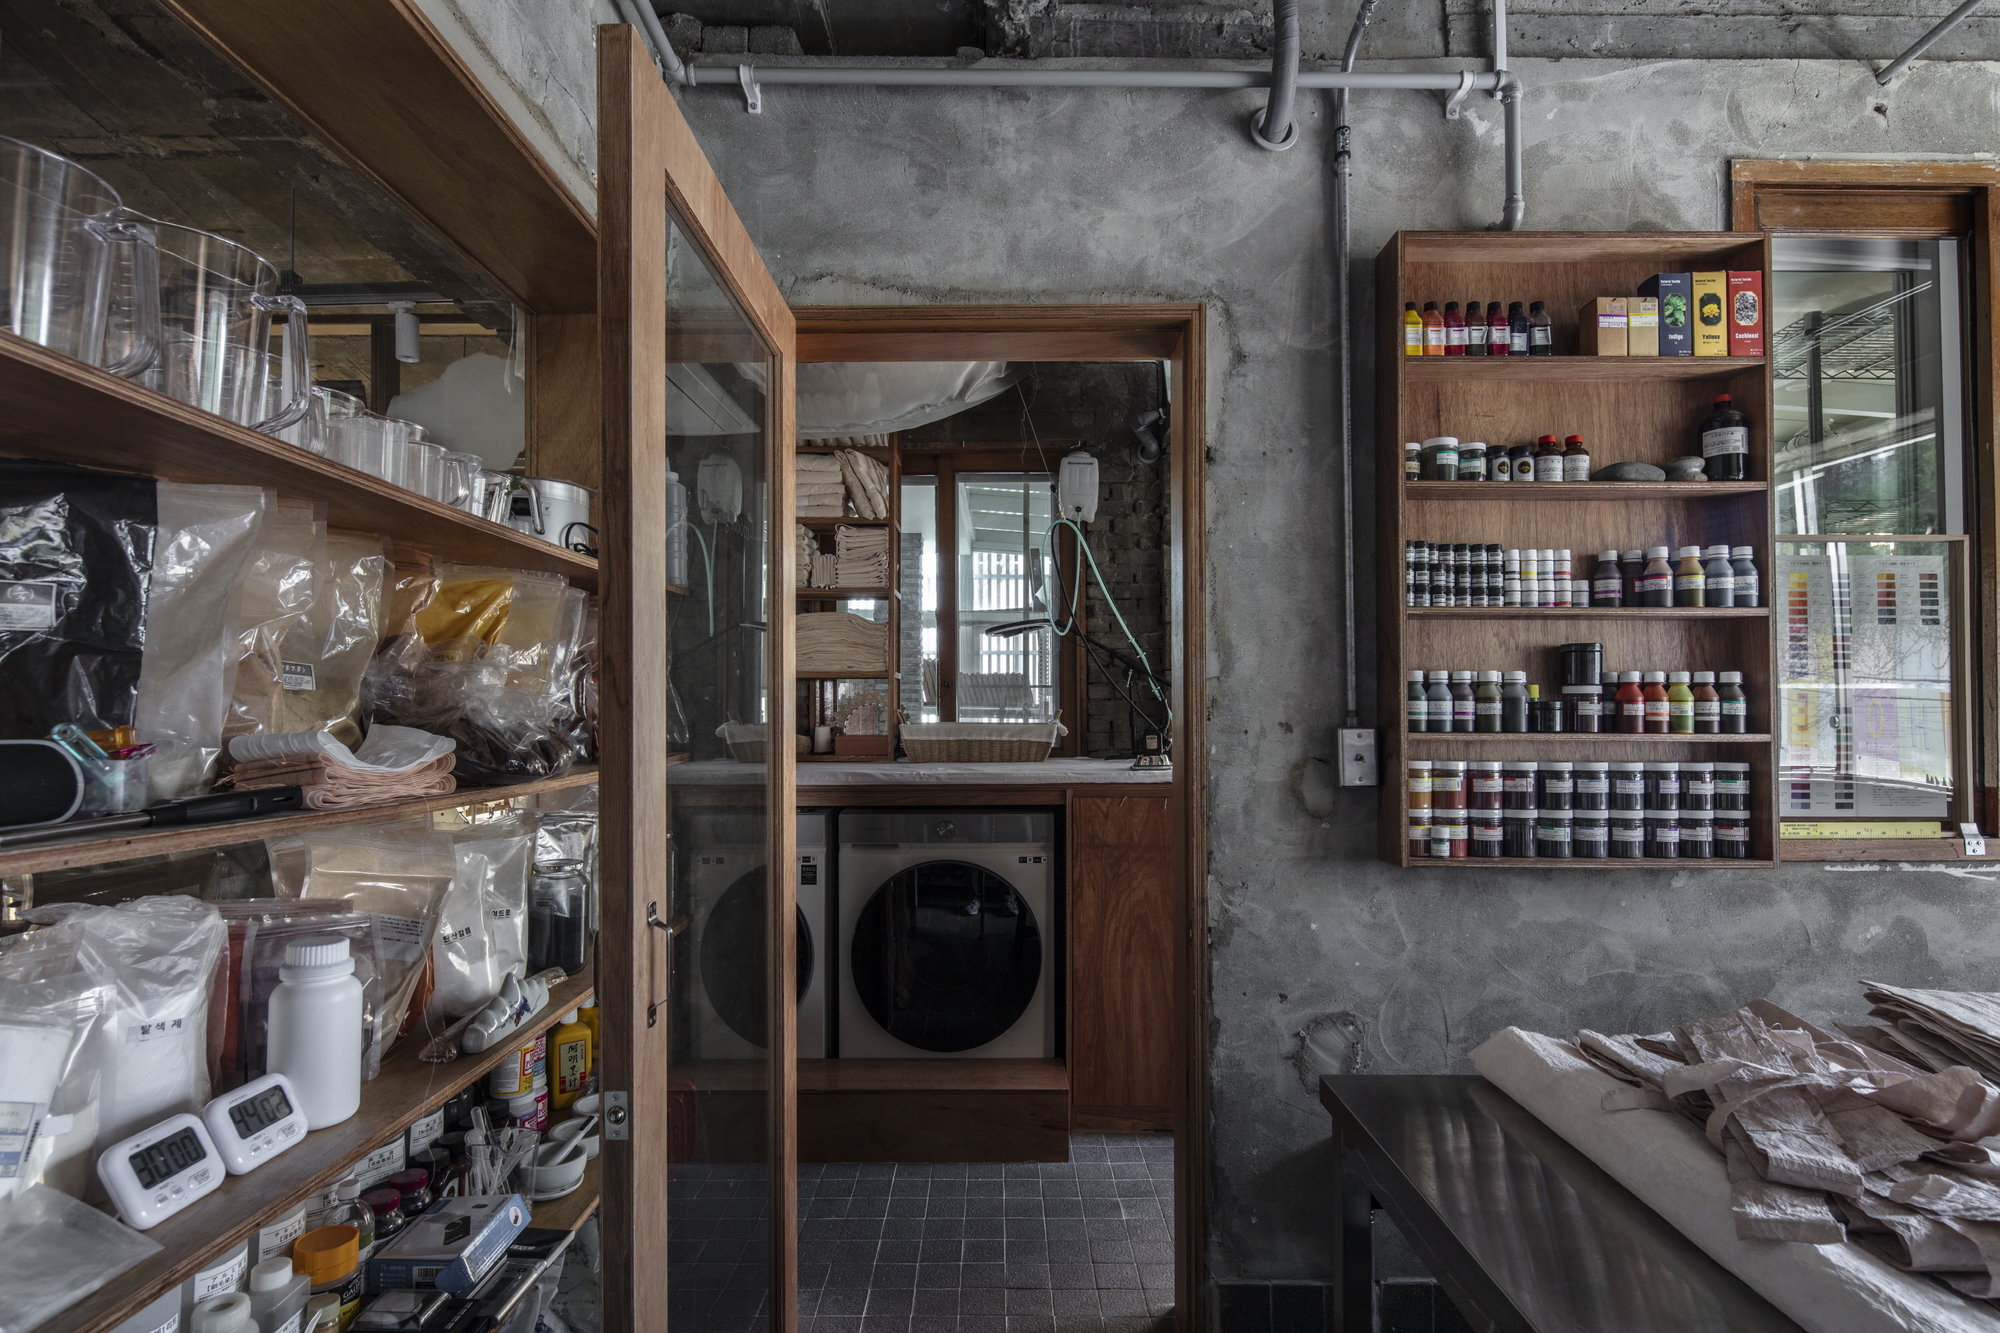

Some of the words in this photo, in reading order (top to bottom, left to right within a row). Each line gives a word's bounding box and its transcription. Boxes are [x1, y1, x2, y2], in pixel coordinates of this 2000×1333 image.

[281, 1124, 295, 1134] START
[284, 1129, 296, 1138] STOP
[264, 1138, 274, 1146] SEC
[193, 1169, 210, 1181] START
[197, 1175, 211, 1186] STOP
[172, 1187, 184, 1196] SEC
